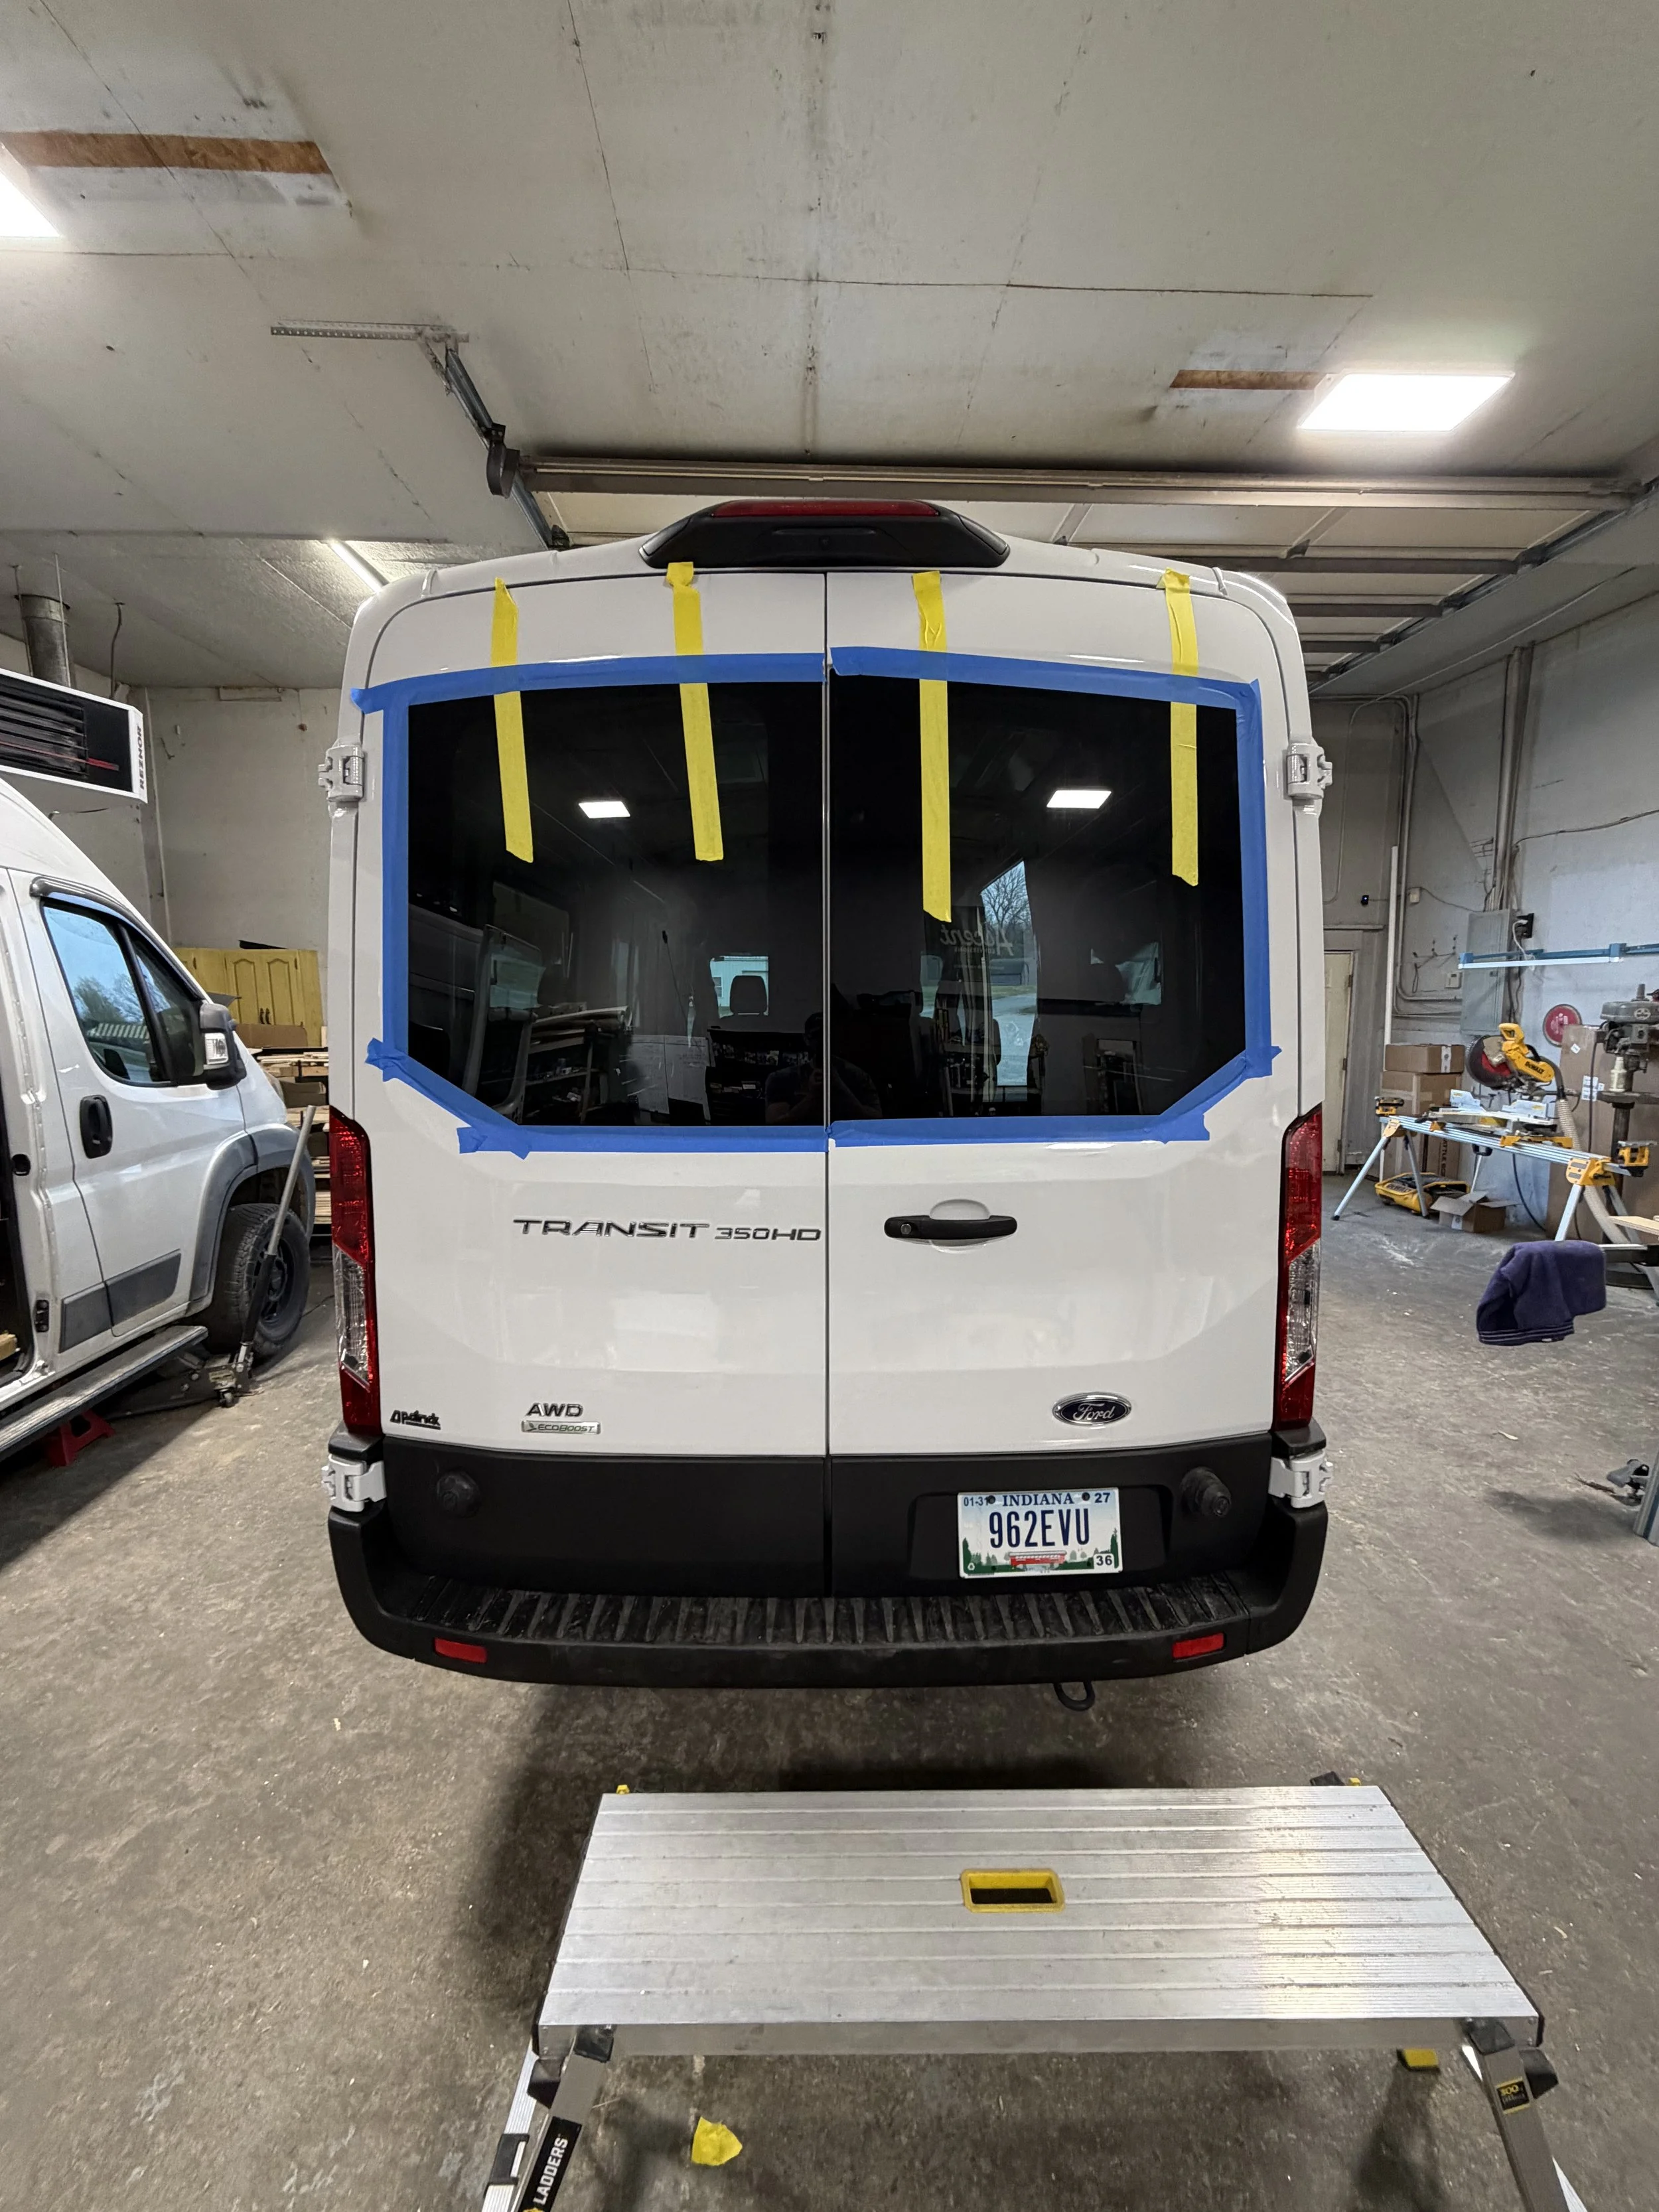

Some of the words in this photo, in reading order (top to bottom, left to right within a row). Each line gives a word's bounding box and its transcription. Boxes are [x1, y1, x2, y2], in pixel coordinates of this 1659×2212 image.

[513, 1219, 710, 1238] TRANSIT
[715, 1227, 822, 1240] 350HD
[525, 1402, 584, 1418] AWD
[1072, 1403, 1116, 1421] Ford
[538, 1424, 595, 1432] ECOBOOST
[1002, 1493, 1075, 1507] INDIANA
[1094, 1493, 1111, 1503] 27
[989, 1509, 1090, 1548] 962EVU
[1096, 1555, 1113, 1566] 36
[534, 2136, 568, 2205] LADDERS
